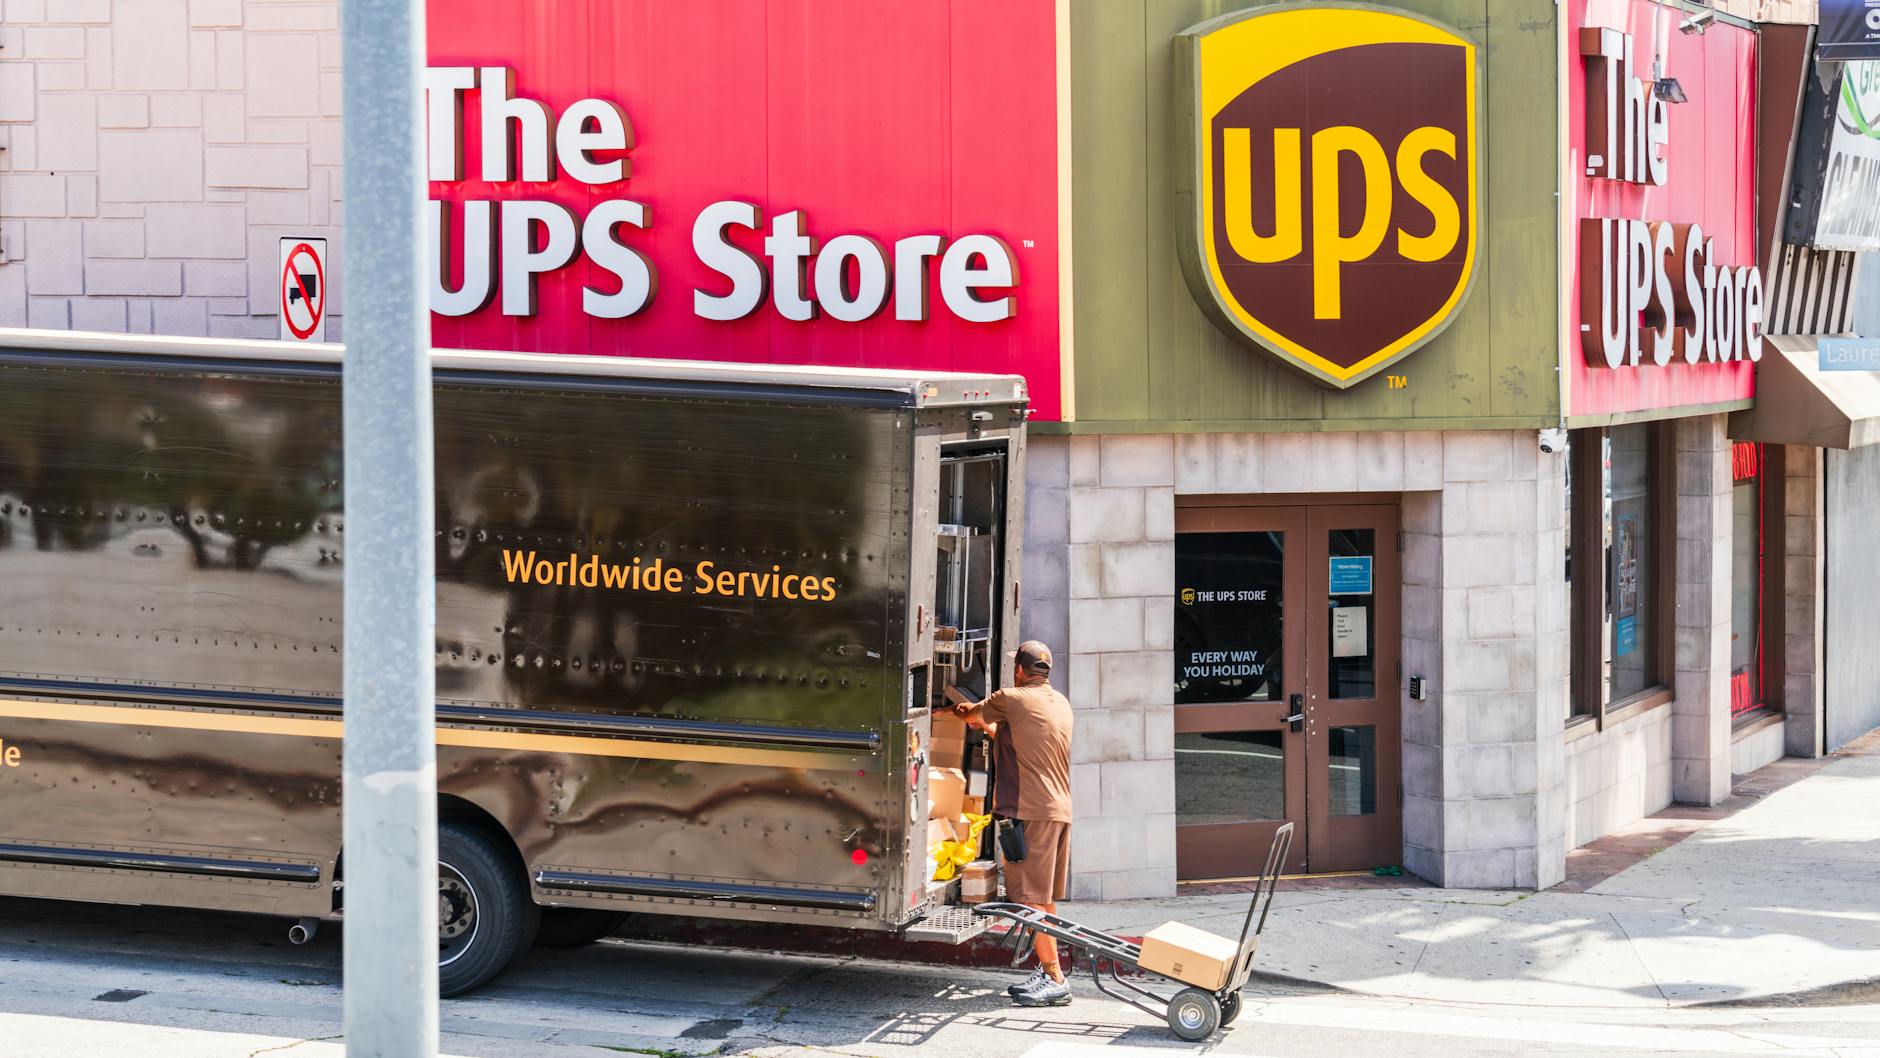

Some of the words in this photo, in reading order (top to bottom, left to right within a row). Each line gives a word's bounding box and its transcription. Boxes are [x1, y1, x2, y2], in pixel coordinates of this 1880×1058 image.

[426, 66, 631, 186] The
[1600, 26, 1668, 187] The
[429, 199, 653, 319] UPS
[691, 199, 1018, 323] Store
[1223, 125, 1461, 320] ups
[1601, 218, 1675, 370] UPS
[1684, 223, 1763, 365] Store
[502, 549, 684, 593] Worldwide
[694, 560, 837, 602] Services
[1197, 591, 1215, 602] THE
[1216, 591, 1236, 601] UPS
[1237, 590, 1266, 600] STORE
[1183, 665, 1210, 678] YOU
[1211, 664, 1265, 677] HOLIDAY
[1191, 651, 1228, 664] EVERY
[1230, 650, 1258, 662] WAY
